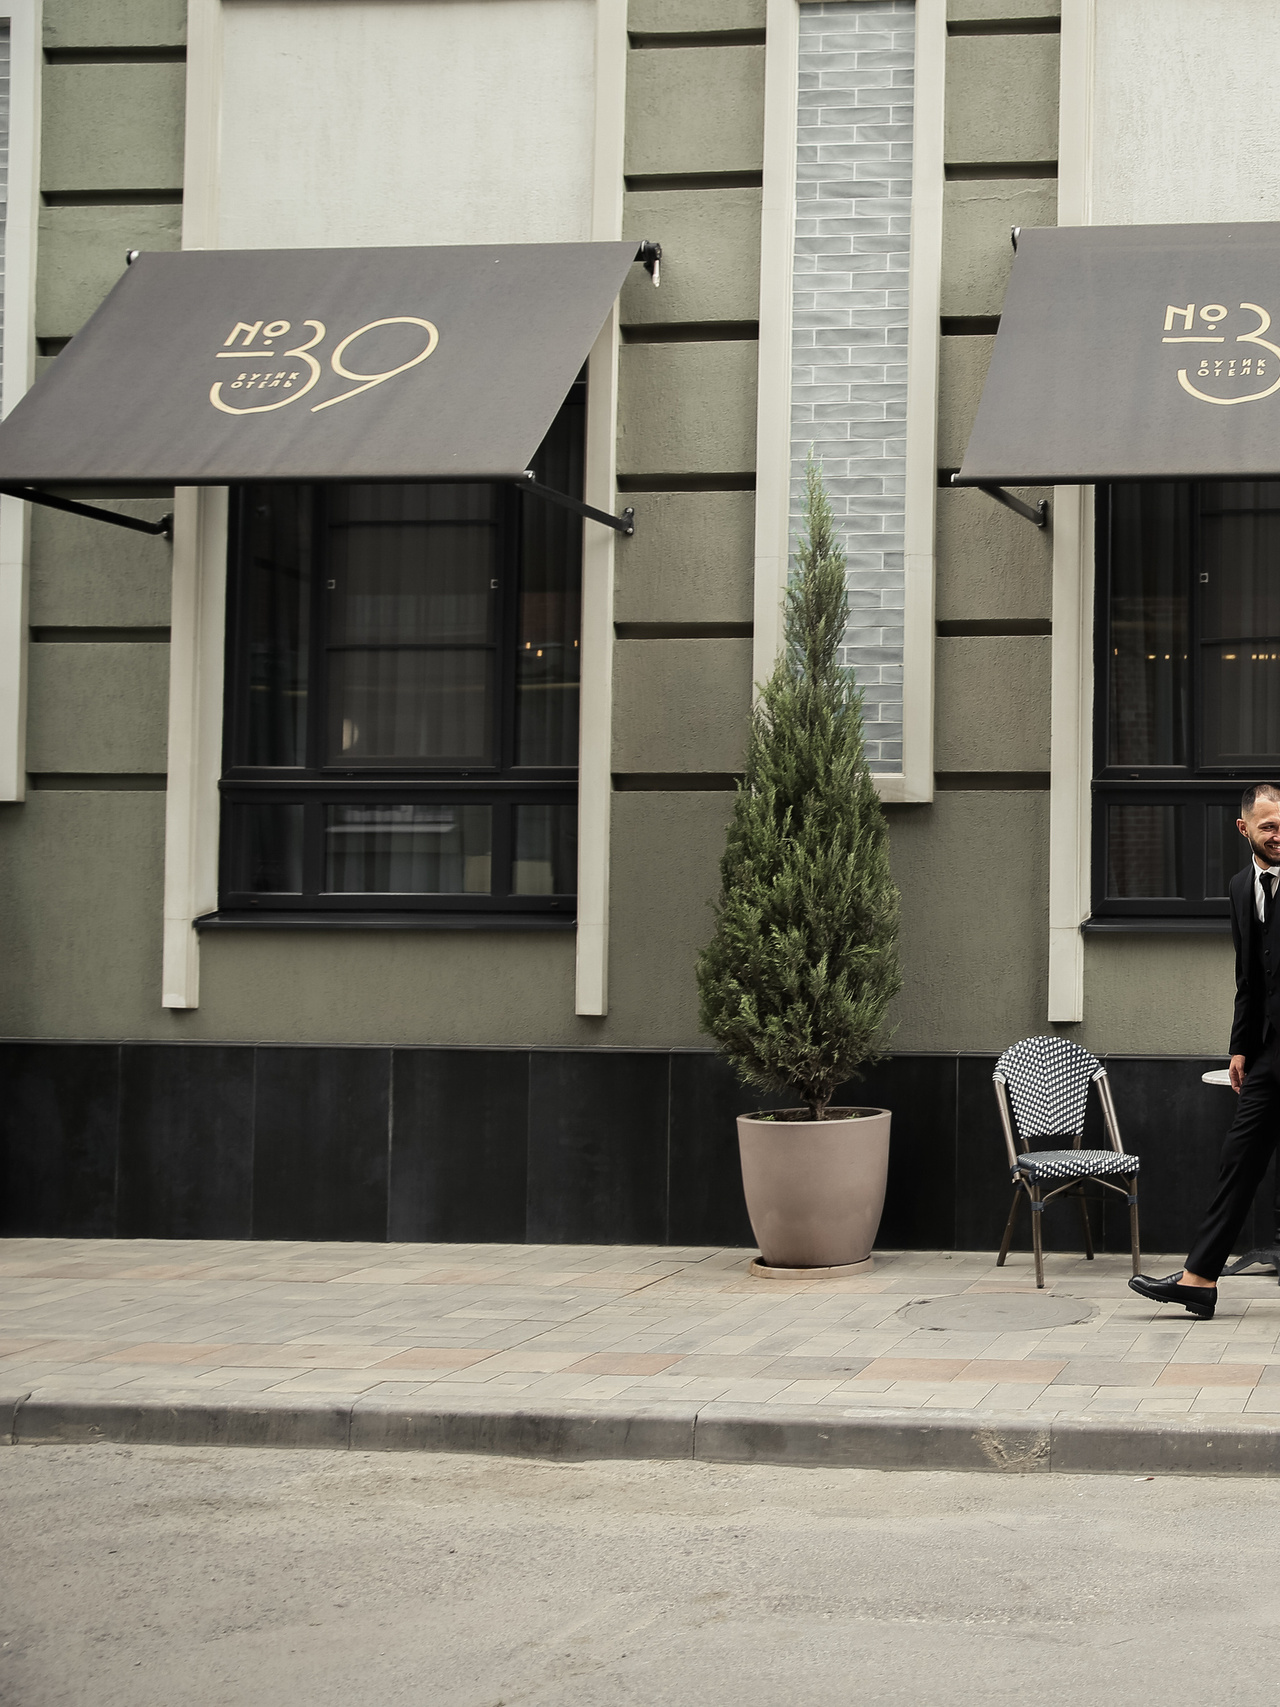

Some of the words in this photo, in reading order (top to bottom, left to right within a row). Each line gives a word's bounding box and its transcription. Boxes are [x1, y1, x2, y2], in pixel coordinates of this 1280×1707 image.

[209, 316, 439, 415] 39
[1200, 358, 1267, 368] БУТИК
[236, 371, 300, 381] БУТИК
[1197, 367, 1265, 377] ОТЕЛЬ
[230, 380, 293, 389] ОТЕЛЬ
